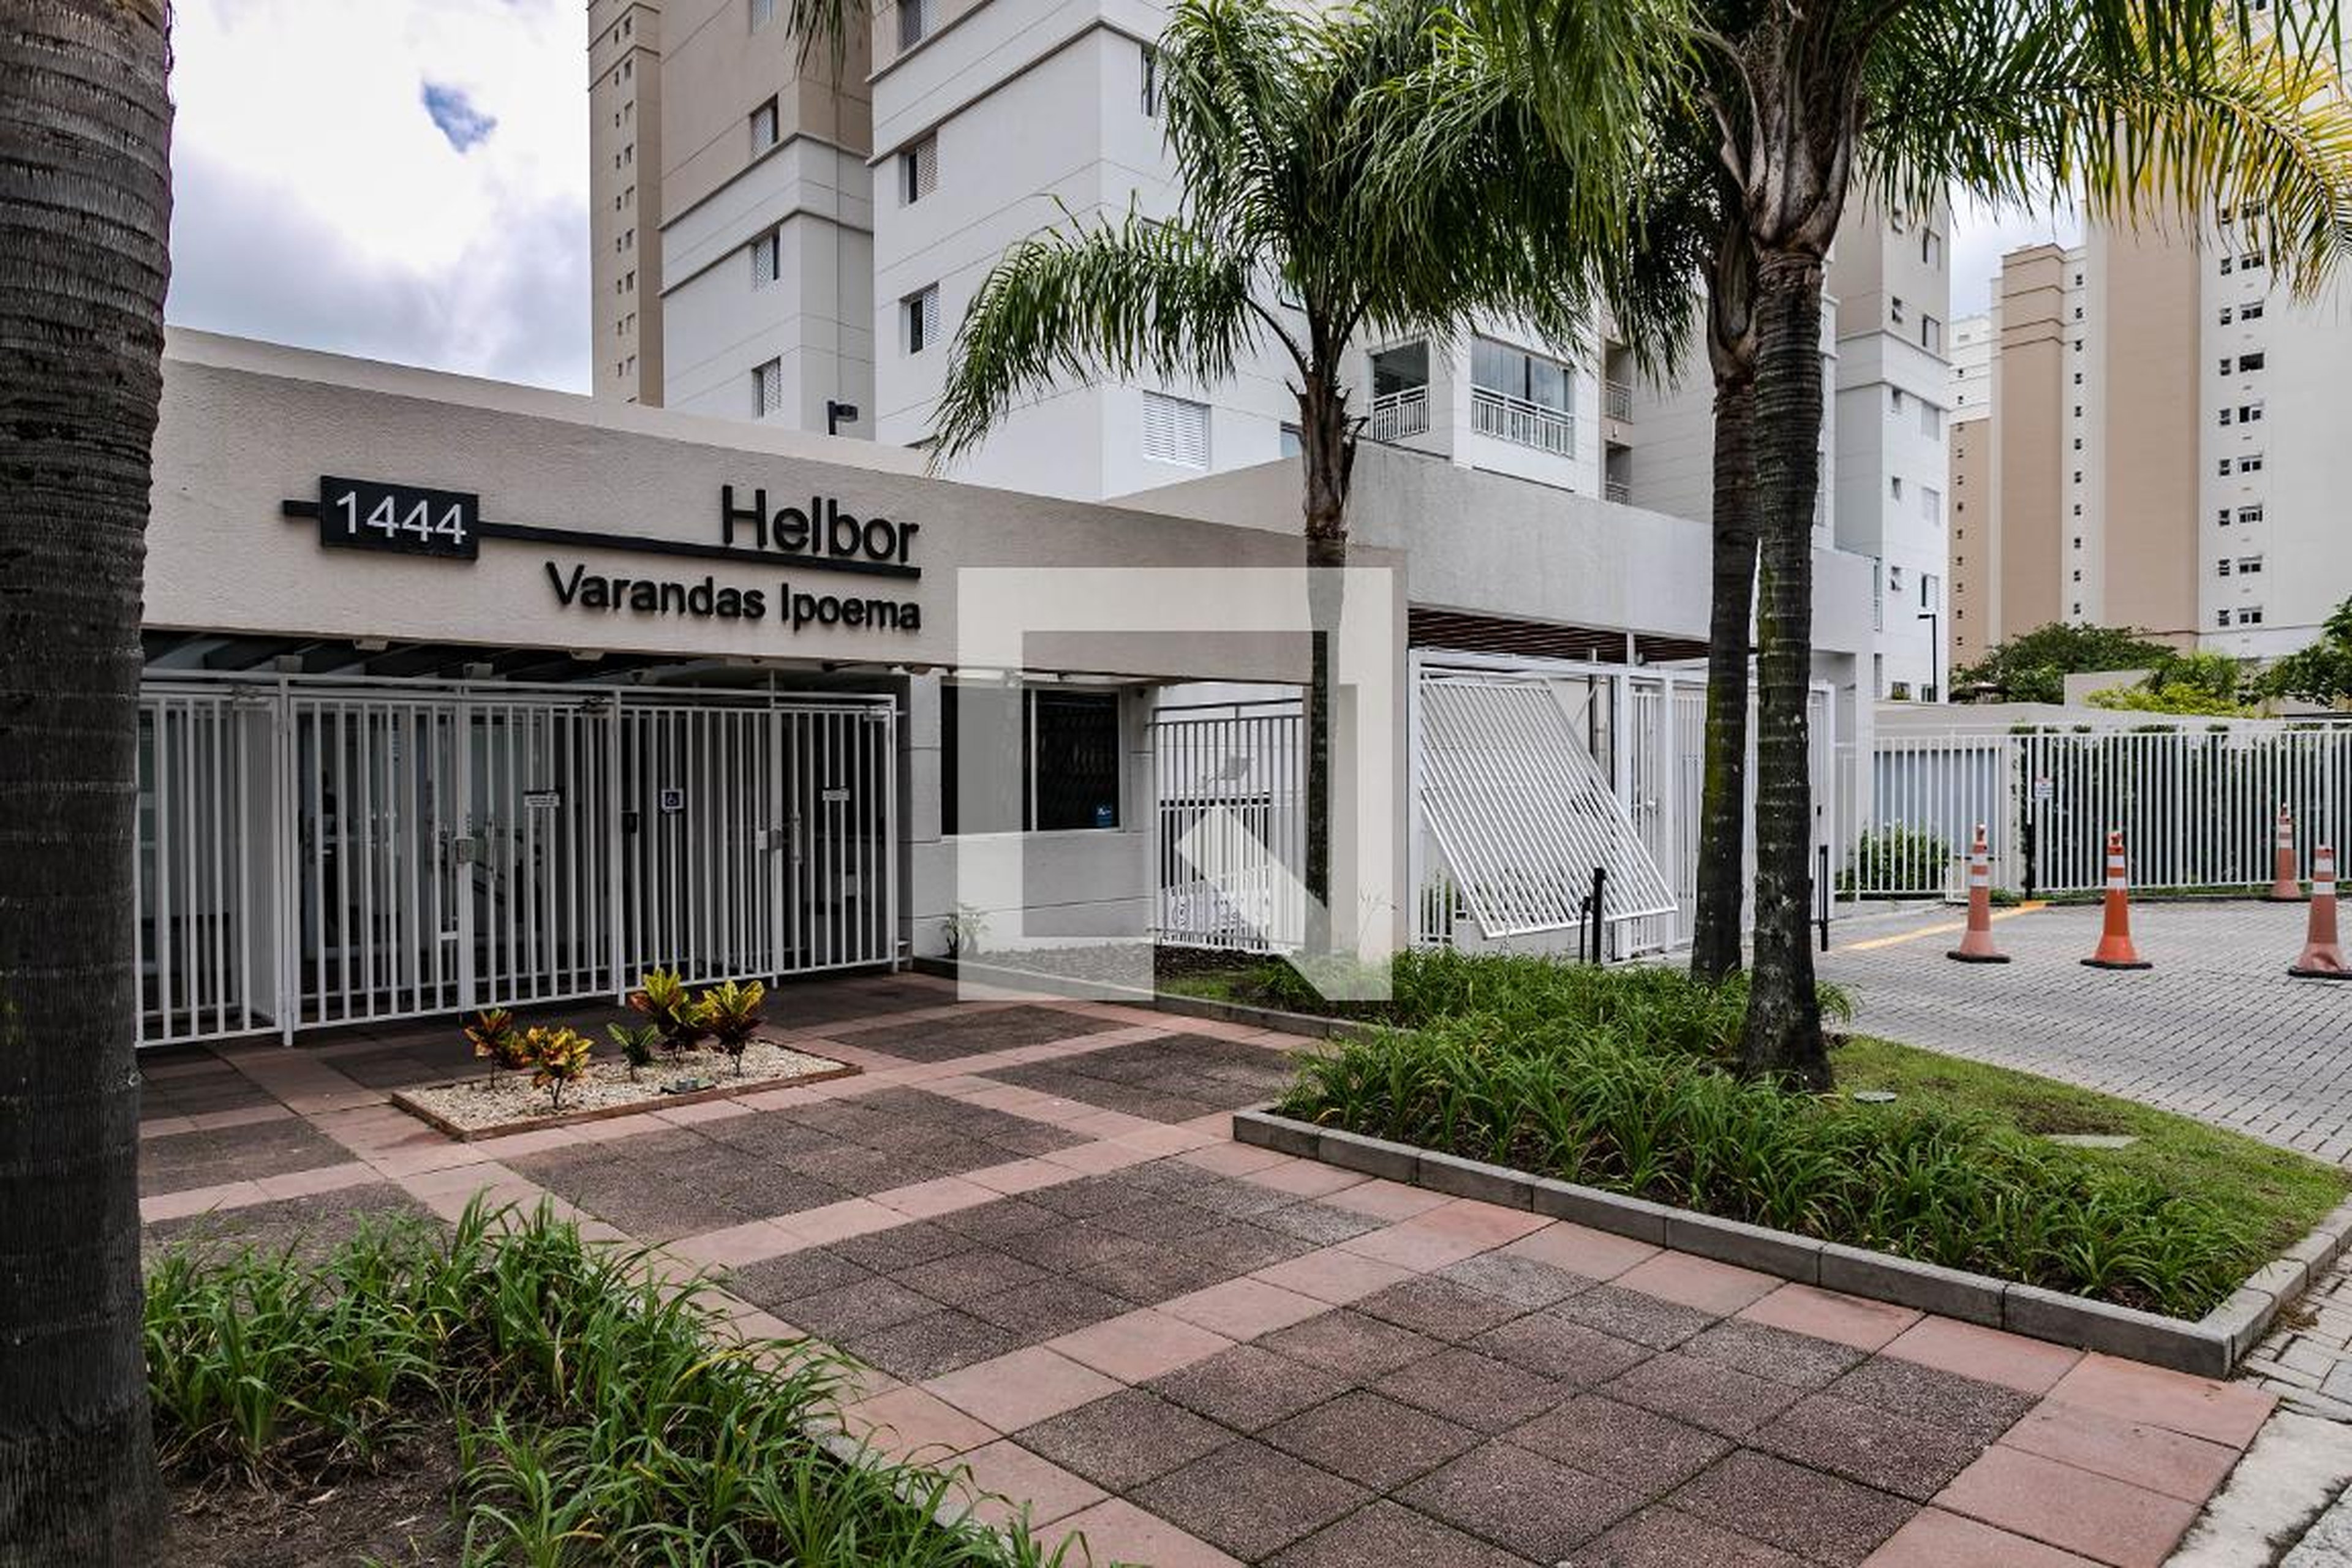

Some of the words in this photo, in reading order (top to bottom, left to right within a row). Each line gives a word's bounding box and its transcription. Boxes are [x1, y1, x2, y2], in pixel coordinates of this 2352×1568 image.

[336, 491, 467, 544] 1444
[722, 484, 920, 564] Helbor
[545, 561, 766, 619] Varandas
[781, 582, 921, 631] Ipoema
